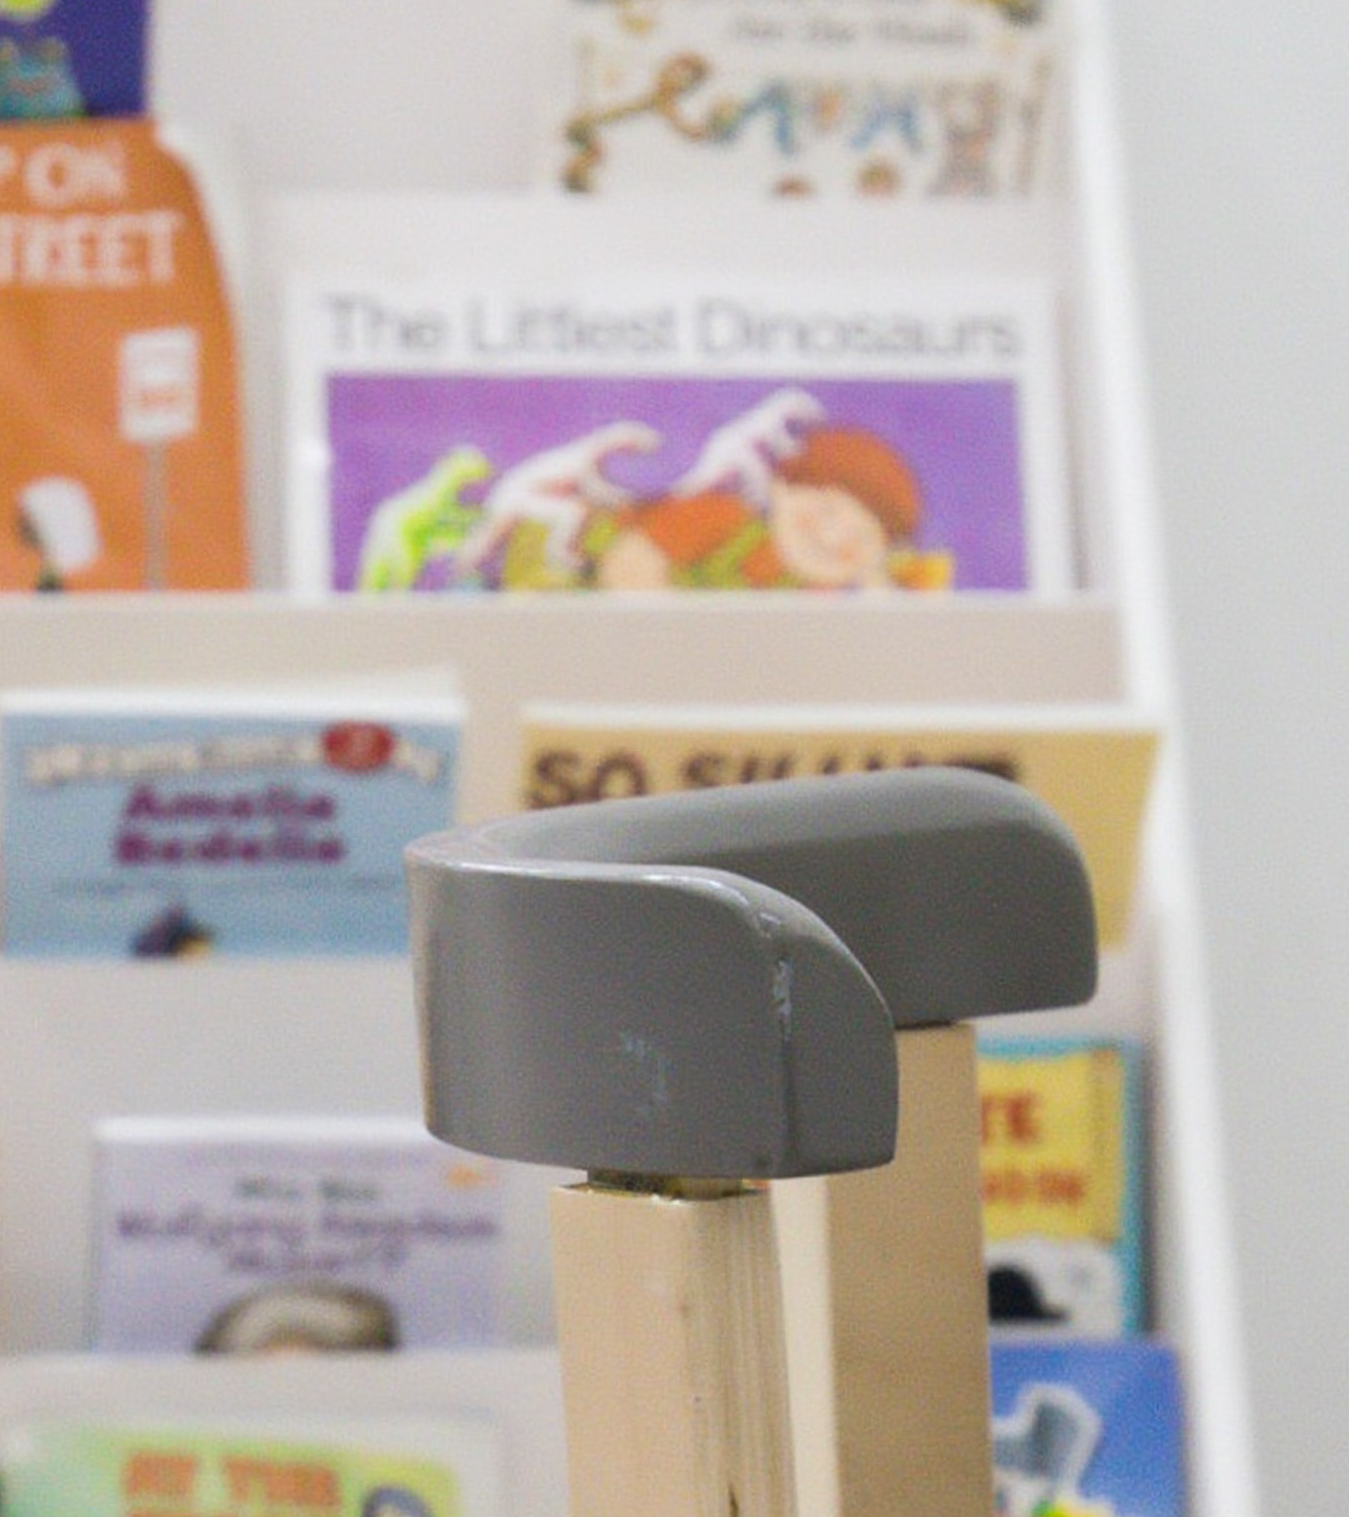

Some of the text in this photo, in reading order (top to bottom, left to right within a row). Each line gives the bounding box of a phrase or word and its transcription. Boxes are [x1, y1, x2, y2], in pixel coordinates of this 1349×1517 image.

[21, 140, 130, 203] ON
[325, 293, 1022, 357] The Littlest Dinosaurs
[122, 1452, 344, 1507] AT THE
